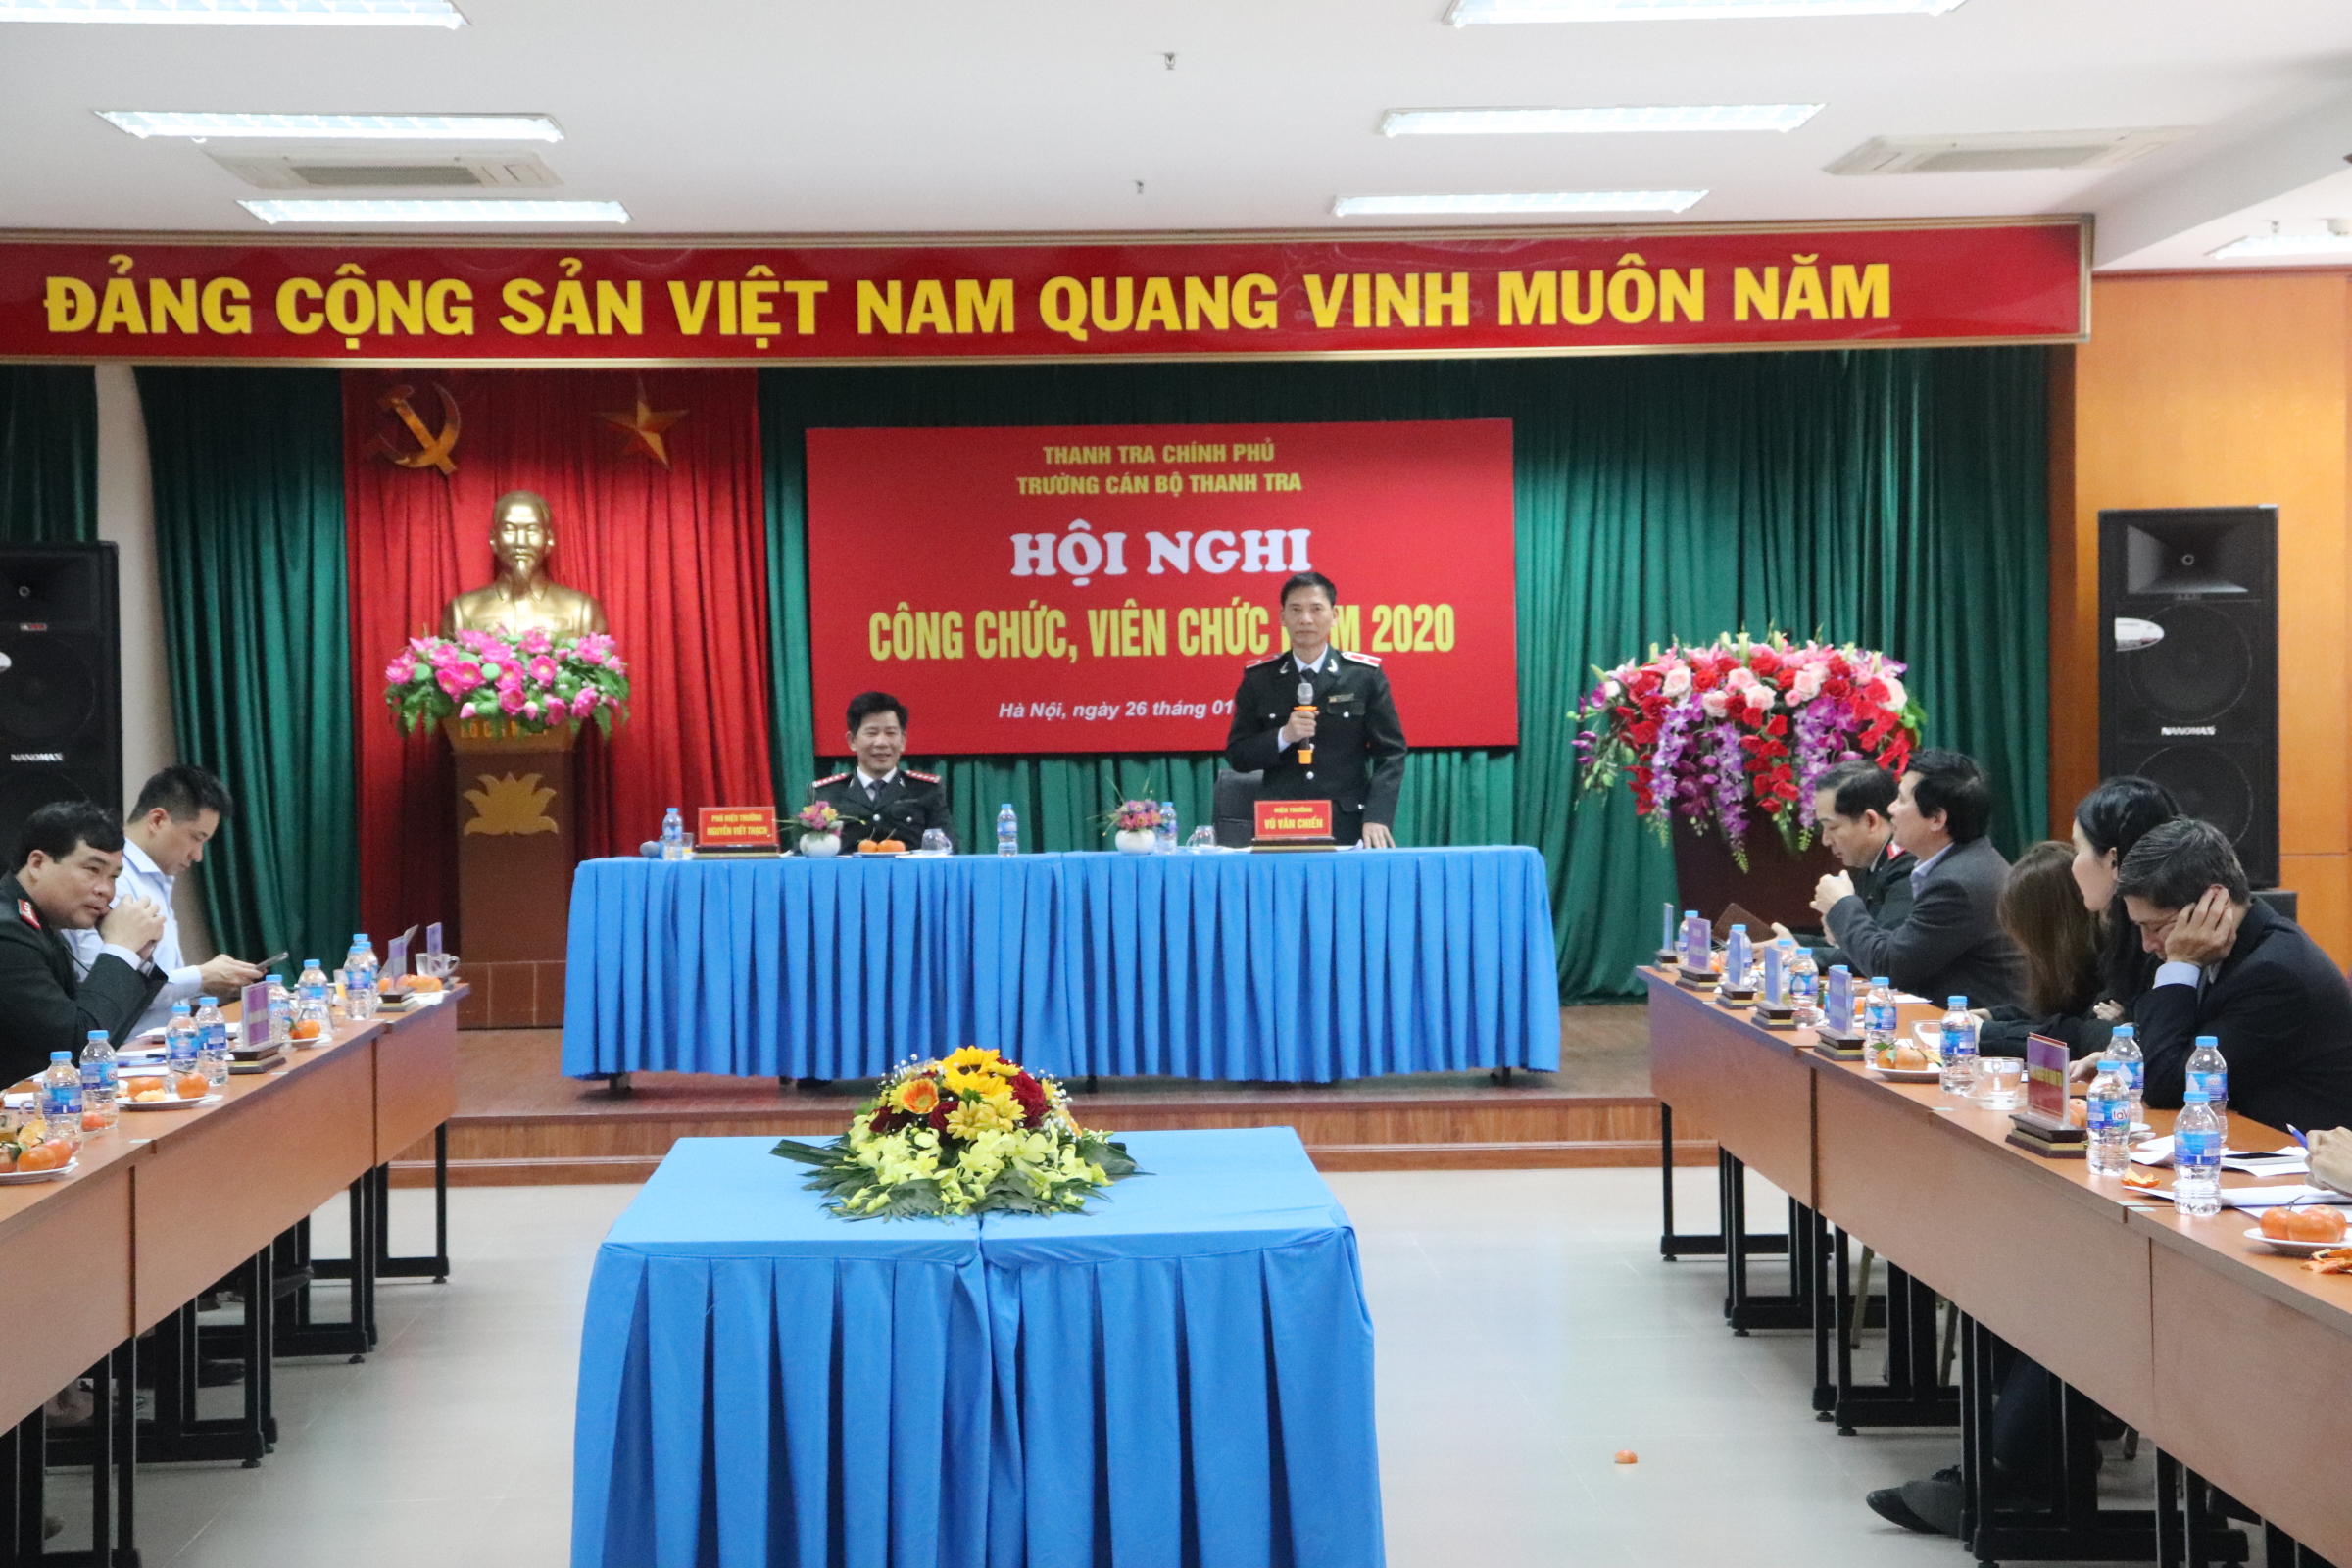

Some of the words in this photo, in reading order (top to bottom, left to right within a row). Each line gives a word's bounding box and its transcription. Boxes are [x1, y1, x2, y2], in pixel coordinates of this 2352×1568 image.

[44, 254, 252, 334] ĐẢNG
[275, 263, 474, 349] CỘNG
[499, 257, 643, 335] SẢN
[667, 264, 828, 348] VIỆT
[858, 278, 1014, 334] NAM
[1039, 273, 1278, 341] QUANG
[1303, 272, 1469, 328] VINH
[1497, 253, 1705, 325] MUÔN
[1733, 253, 1890, 320] NĂM
[1042, 445, 1111, 465] THANH
[1117, 445, 1155, 464] TRA
[1162, 441, 1227, 464] CHÍNH
[1232, 437, 1275, 462] PHỦ
[1016, 472, 1100, 495] TRƯỜNG
[1105, 472, 1150, 494] CÁN
[1154, 471, 1183, 497] BỘ
[1189, 473, 1258, 493] THANH
[1263, 472, 1303, 491] TRA
[1010, 518, 1128, 586] HỘI
[868, 601, 964, 661] CÔNG
[974, 599, 1077, 663] CHỨC,
[1087, 598, 1167, 657] VIÊN
[1177, 596, 1269, 656] CHỨC
[1371, 603, 1455, 653] 2020
[999, 702, 1025, 718] Hà
[1029, 702, 1067, 720] Nội,
[1072, 702, 1120, 721] ngày
[1125, 701, 1148, 716] 26
[1152, 700, 1206, 719] tháng
[1211, 699, 1234, 715] 01
[11, 753, 64, 761] NANOMAX
